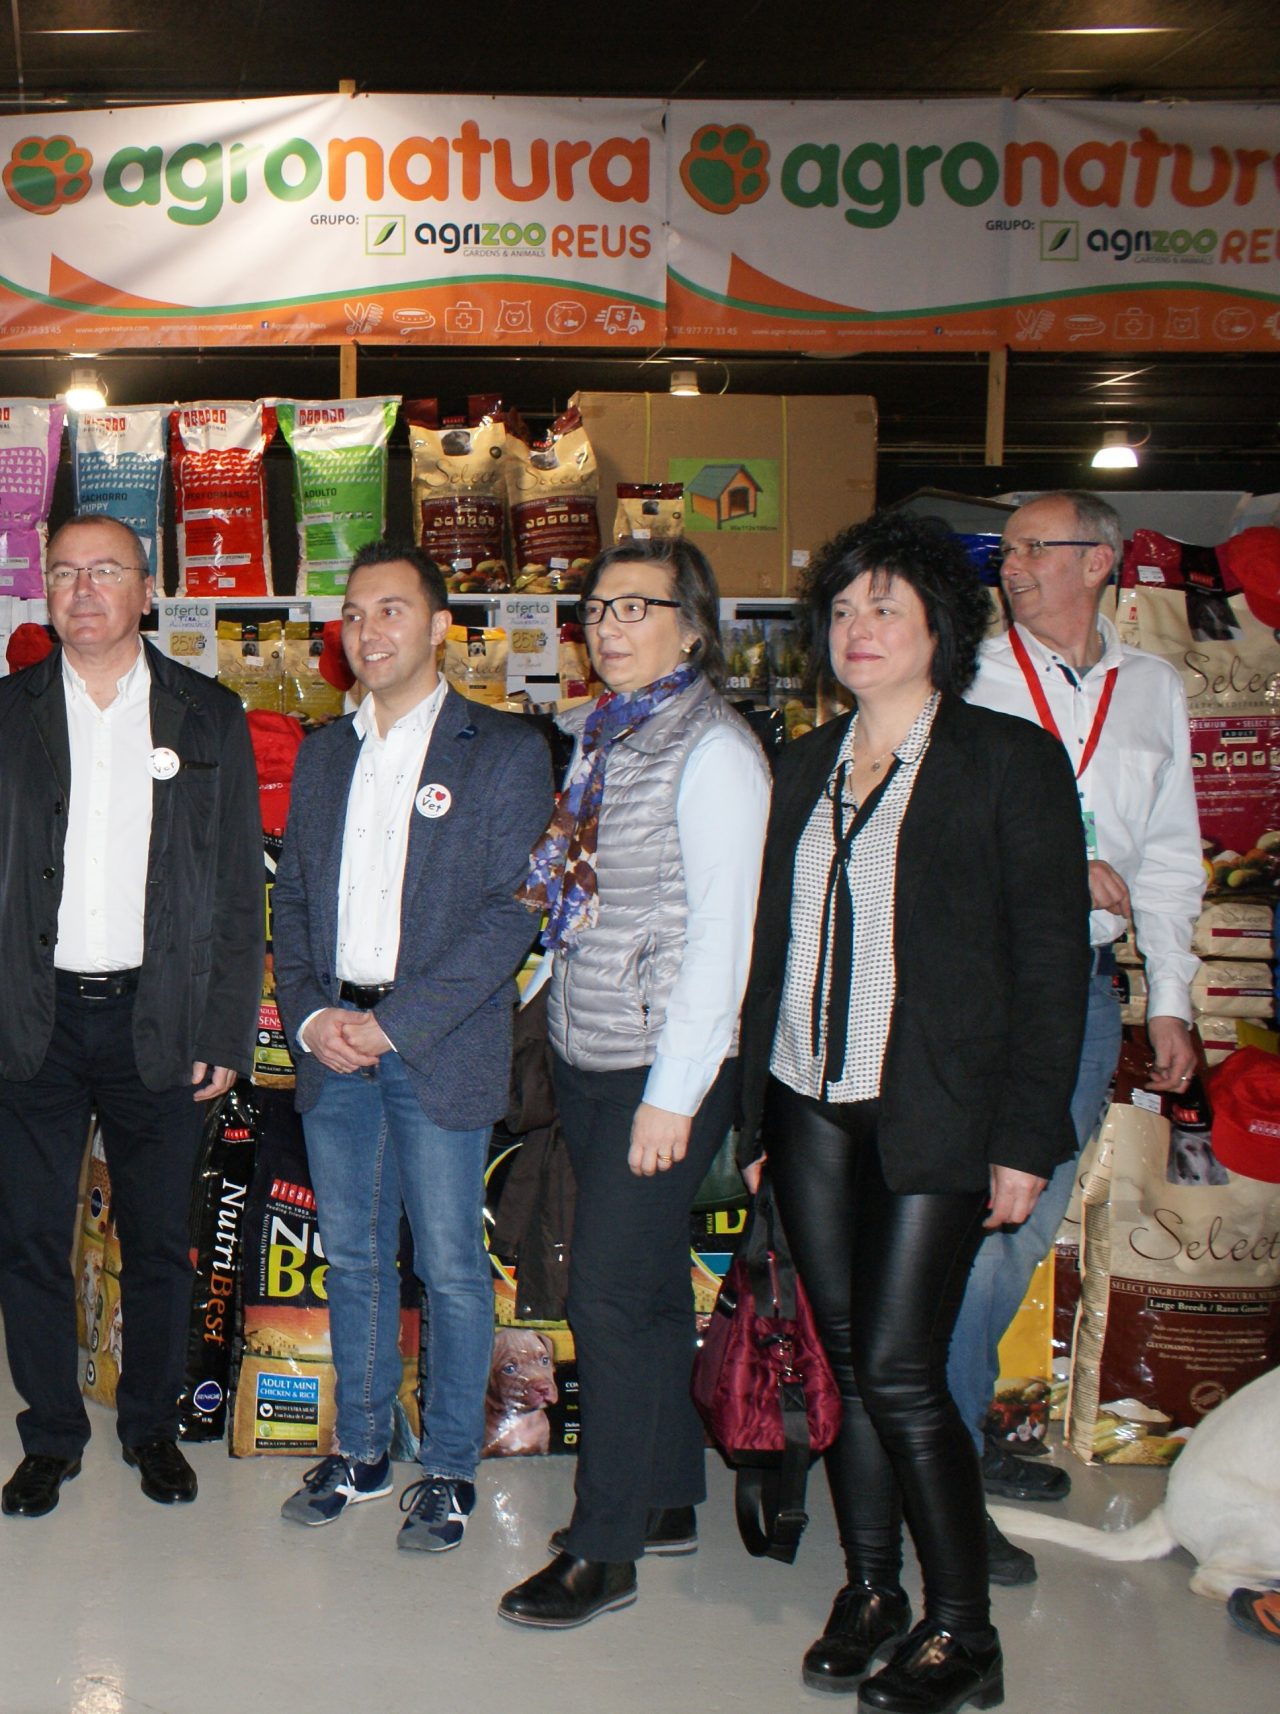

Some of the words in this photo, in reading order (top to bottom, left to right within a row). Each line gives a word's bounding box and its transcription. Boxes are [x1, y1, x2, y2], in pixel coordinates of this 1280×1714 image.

[103, 119, 651, 227] agronatura
[781, 127, 1280, 229] agronatur
[310, 214, 359, 226] GRUPO:
[985, 219, 1035, 231] GRUPO:
[414, 222, 547, 254] agrizoo
[551, 223, 652, 259] REUS
[1086, 228, 1219, 261] agrizoo
[1220, 228, 1280, 265] RE
[165, 604, 209, 617] oferta
[506, 601, 550, 614] oferta
[1223, 730, 1255, 738] ADULT
[425, 787, 436, 798] I
[422, 797, 442, 812] Vet
[270, 1179, 317, 1211] picar
[1128, 1208, 1280, 1262] Select
[1111, 1280, 1144, 1294] SELECT
[1147, 1283, 1213, 1299] INGREDIENTS
[1149, 1299, 1175, 1311] Large
[261, 1378, 292, 1389] ADULT
[292, 1381, 316, 1390] MINI
[260, 1388, 291, 1397] CHICKEN
[299, 1391, 315, 1399] RICE
